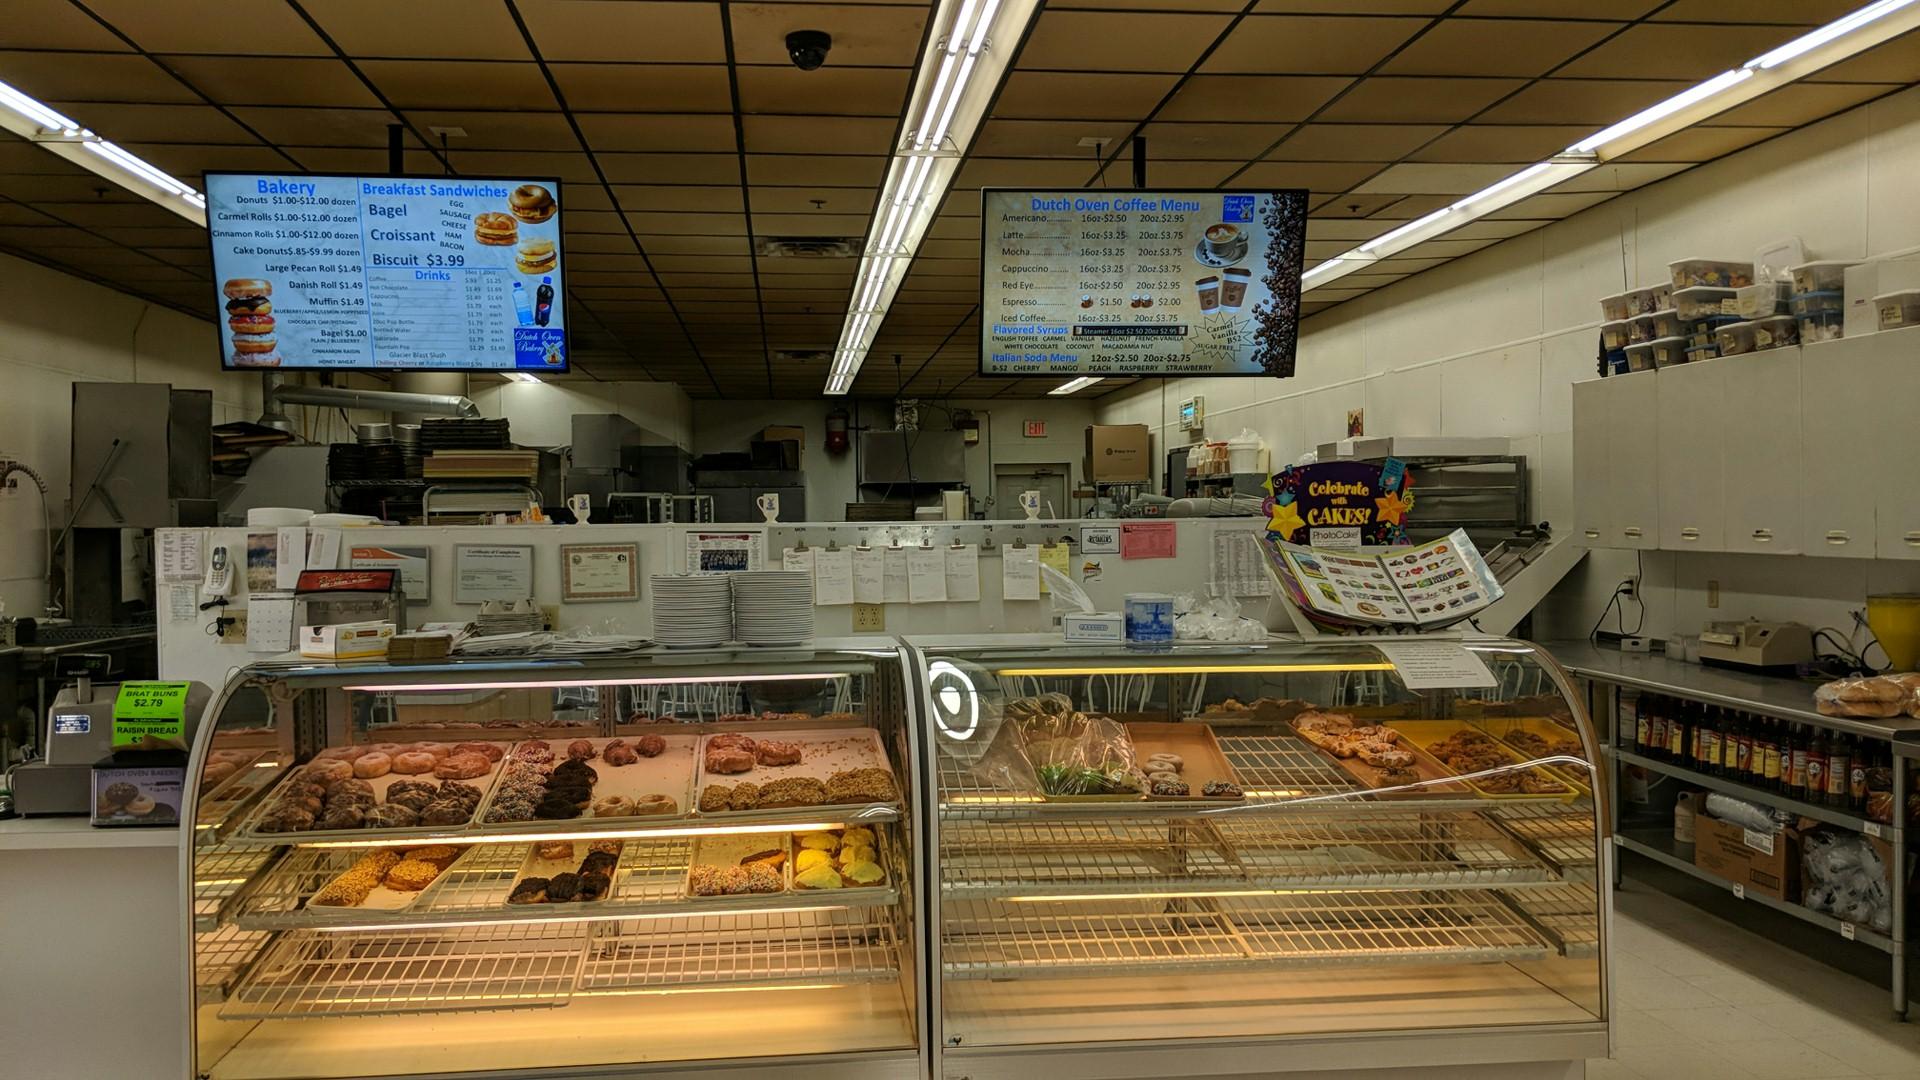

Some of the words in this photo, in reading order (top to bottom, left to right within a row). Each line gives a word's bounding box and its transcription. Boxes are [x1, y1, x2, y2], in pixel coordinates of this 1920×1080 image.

[257, 179, 316, 197] Bakery
[363, 183, 426, 195] Breakfast
[430, 184, 508, 198] Sandwiches
[236, 196, 268, 204] Donuts
[272, 196, 329, 206] $1.00-$12.00
[450, 200, 464, 208] EGG
[1032, 199, 1070, 212] Dutch
[1075, 199, 1108, 212] Oven
[1114, 199, 1156, 212] Coffee
[1161, 199, 1200, 212] Menu
[369, 204, 407, 218] Bagel
[440, 209, 472, 220] SAUSAGE
[218, 212, 249, 220] Carmel
[251, 213, 272, 221] Rolls
[274, 214, 330, 222] $1.00-$12.00
[1082, 214, 1126, 223] 16oz-$2.50
[1140, 214, 1184, 223] 20oz.$2.95
[442, 220, 466, 230] CHEESE
[212, 230, 252, 238] Cinnamon
[254, 230, 274, 238] Rolls
[276, 230, 332, 239] $1.00-$12.00
[370, 229, 436, 240] Croissant
[445, 232, 462, 240] HAM
[1082, 231, 1126, 240] 16oz-$3.25
[1139, 231, 1184, 240] 20oz.$3.75
[440, 242, 464, 250] BACON
[234, 246, 254, 254] Cake
[336, 248, 360, 256] dozen
[1080, 248, 1124, 256] 16oz-$3.25
[1138, 248, 1182, 256] 20oz.$3.75
[373, 254, 420, 266] Biscuit
[426, 254, 464, 267] $3.99
[266, 264, 288, 273] Large
[291, 264, 316, 272] Pecan
[338, 265, 362, 273] $1.49
[1002, 265, 1048, 273] Cappuccino
[1080, 265, 1124, 274] 16oz-$3.25
[1137, 265, 1181, 274] 20oz.$3.75
[416, 270, 450, 280] Drinks
[340, 282, 362, 290] $1.49
[1079, 282, 1123, 290] 16oz-$2.50
[1136, 282, 1180, 290] 20oz.$2.95
[340, 298, 364, 306] $1.49
[1100, 298, 1122, 306] $1.50
[1158, 298, 1180, 306] $2.00
[1002, 314, 1018, 322] Iced
[1078, 314, 1121, 322] 16oz-$3.25
[1134, 314, 1178, 322] 20oz.$3.75
[994, 325, 1034, 334] Flavored
[1037, 326, 1068, 335] Syrups
[1206, 322, 1234, 333] Carmel
[321, 330, 343, 338] Bagel
[345, 330, 367, 338] $1.00
[1212, 330, 1238, 340] Vanilla
[1228, 335, 1242, 344] B52
[992, 354, 1020, 362] Italian
[1024, 354, 1047, 362] Soda
[1050, 354, 1078, 362] Menu
[1091, 354, 1138, 362] 12oz-$2.50
[1144, 354, 1190, 362] 20oz-$2.75
[1028, 422, 1045, 434] EXIT
[1308, 480, 1370, 496] Celebrate
[1331, 497, 1348, 505] with
[1308, 508, 1371, 526] CAKES!
[134, 699, 162, 707] $2.79
[117, 726, 145, 734] RAISIN
[148, 726, 178, 734] BREAD
